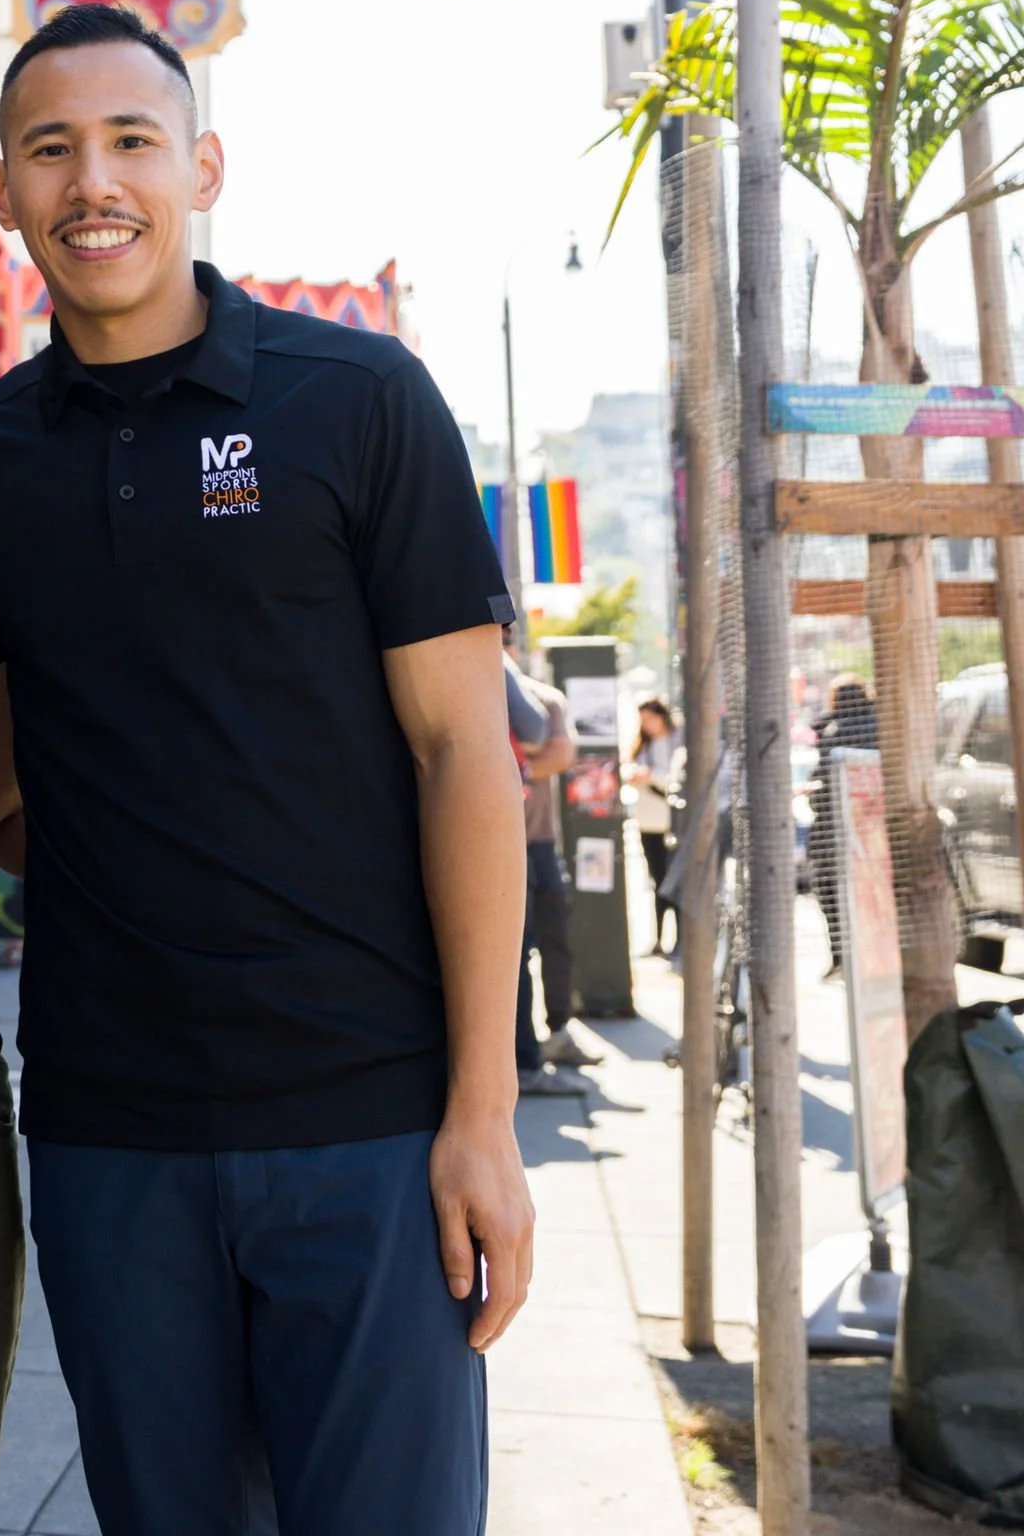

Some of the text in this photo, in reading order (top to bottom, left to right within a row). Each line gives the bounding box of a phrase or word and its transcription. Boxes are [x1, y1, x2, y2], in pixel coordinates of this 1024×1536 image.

[202, 466, 256, 484] MIDPOINT
[202, 477, 259, 493] SPORTS
[203, 487, 259, 507] CHIRO
[203, 501, 261, 519] PRACTIC
